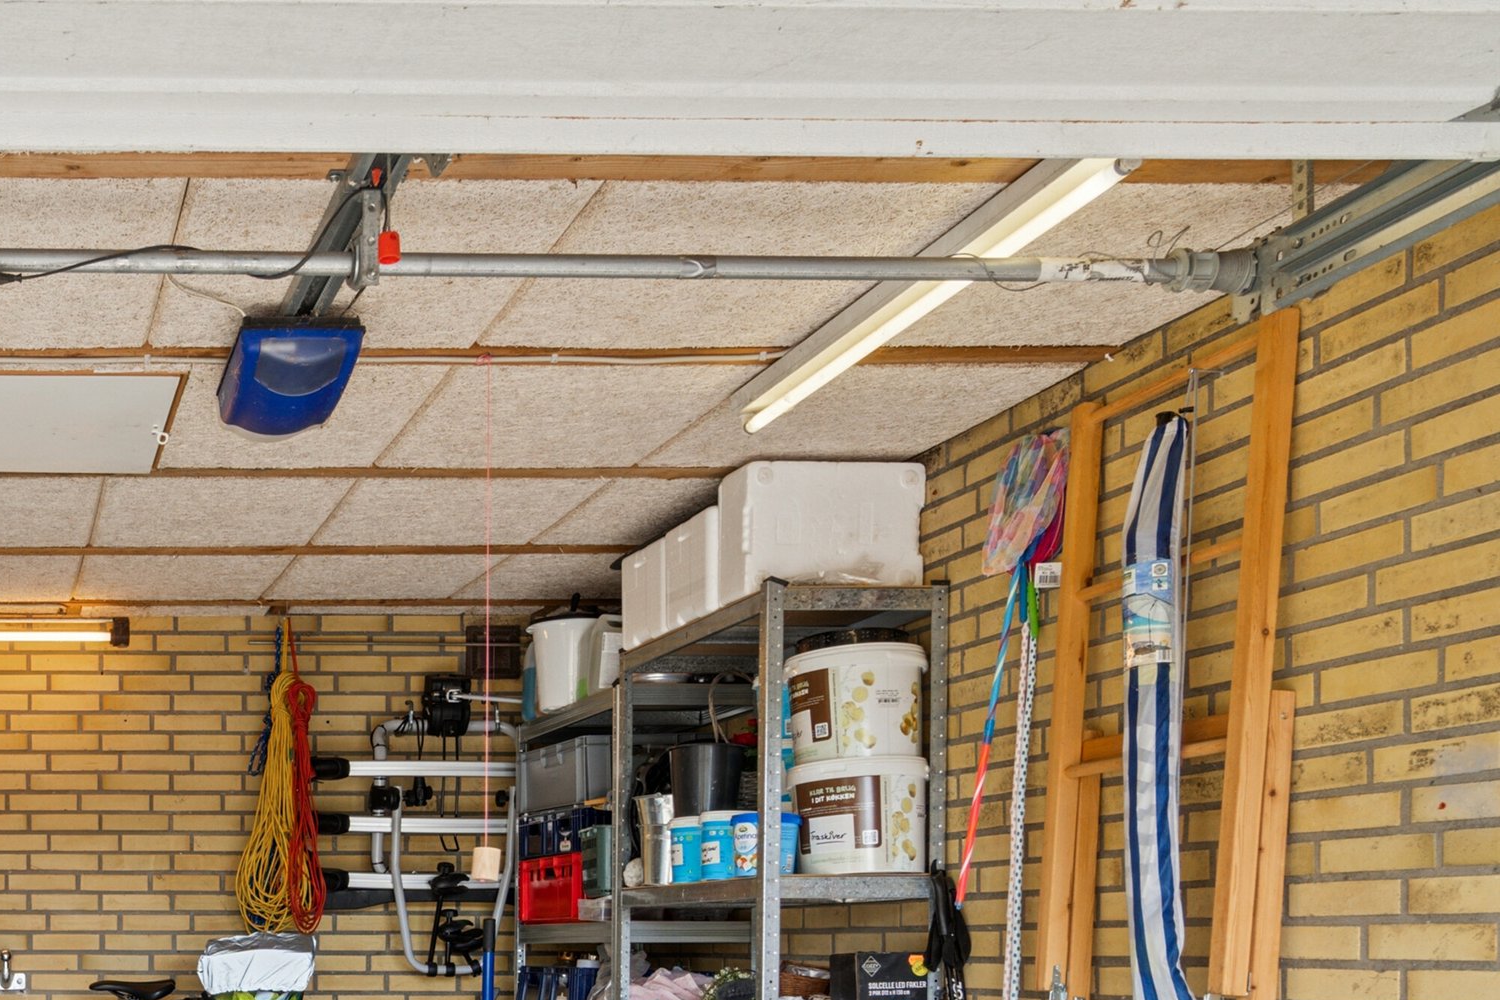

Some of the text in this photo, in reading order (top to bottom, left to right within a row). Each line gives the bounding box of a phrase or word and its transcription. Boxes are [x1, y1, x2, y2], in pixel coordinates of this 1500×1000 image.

[809, 784, 856, 797] KLAR TIL BRUG
[826, 792, 856, 803] KØKKEN
[867, 980, 927, 990] SOLCELLE LED FAKLER
